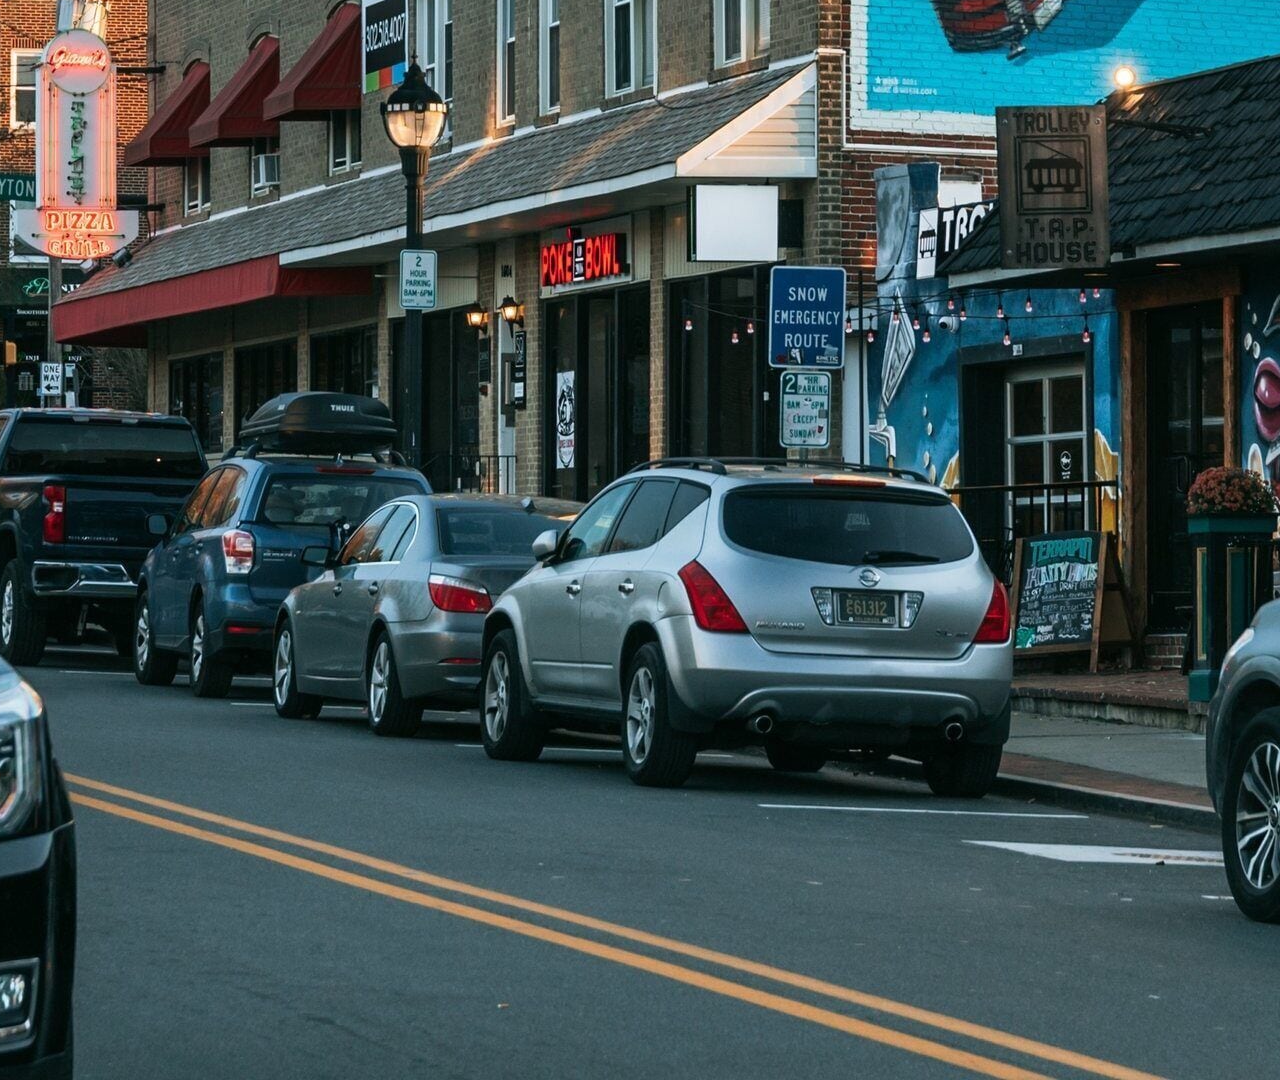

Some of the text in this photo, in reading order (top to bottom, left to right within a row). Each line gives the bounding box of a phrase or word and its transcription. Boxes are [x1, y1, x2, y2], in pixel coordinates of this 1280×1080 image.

[1012, 112, 1091, 134] TROLLEY
[45, 211, 115, 232] PIZZA
[48, 240, 111, 258] GRILL
[1015, 240, 1098, 264] HOUSE
[415, 256, 422, 268] 2
[585, 233, 620, 280] BOWL
[409, 270, 427, 278] HOUR
[405, 279, 432, 288] PARKING
[787, 286, 828, 302] SNOW
[774, 309, 841, 326] EMERGENCY
[784, 333, 830, 348] ROUTE
[43, 364, 60, 374] ONE
[43, 374, 61, 382] WAY
[785, 374, 819, 393] 2 HR
[797, 384, 828, 394] PARKING
[330, 404, 356, 413] THULE
[786, 400, 801, 410] 8AM
[810, 401, 825, 410] 6PM
[792, 414, 818, 424] EXCEPT
[789, 428, 817, 439] SUNDAY
[854, 600, 888, 616] 61312
